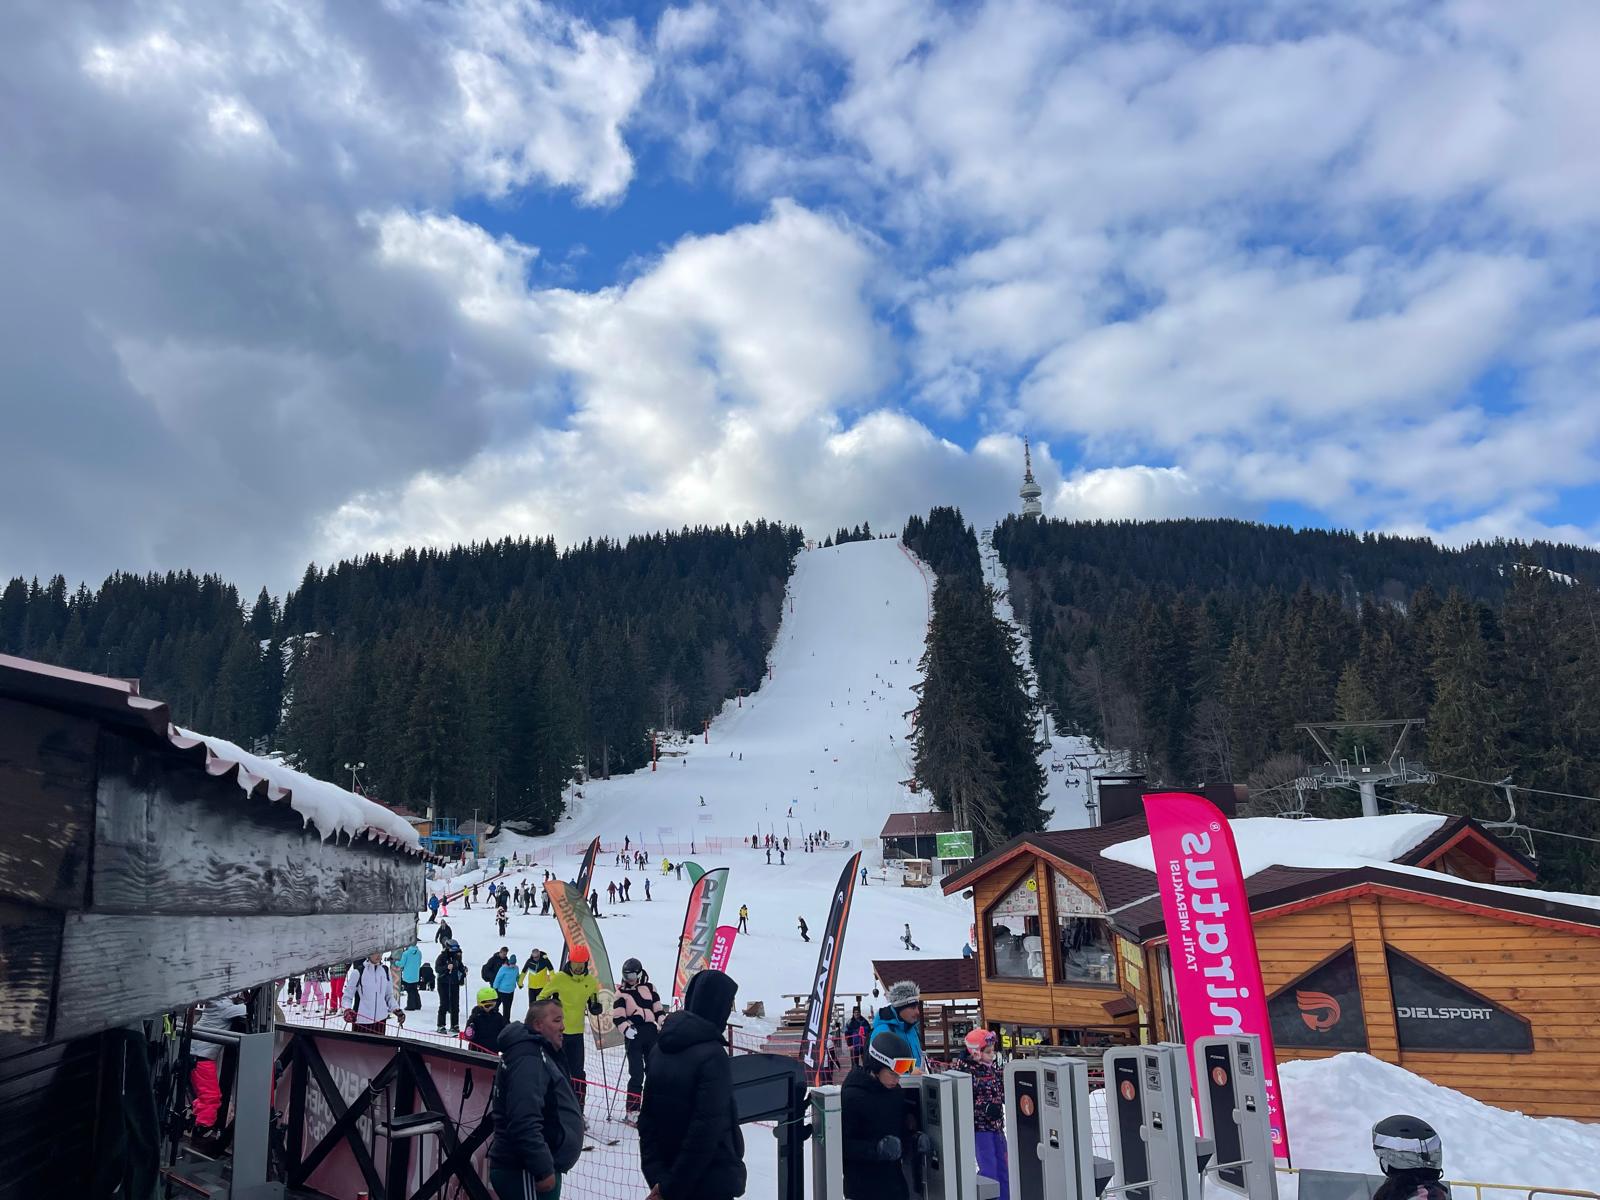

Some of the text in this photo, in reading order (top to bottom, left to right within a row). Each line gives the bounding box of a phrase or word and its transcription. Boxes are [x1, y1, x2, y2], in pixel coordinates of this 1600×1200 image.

[682, 879, 718, 993] PIZZ
[804, 935, 835, 1068] HEAD
[1397, 1006, 1493, 1020] DIELSPORT
